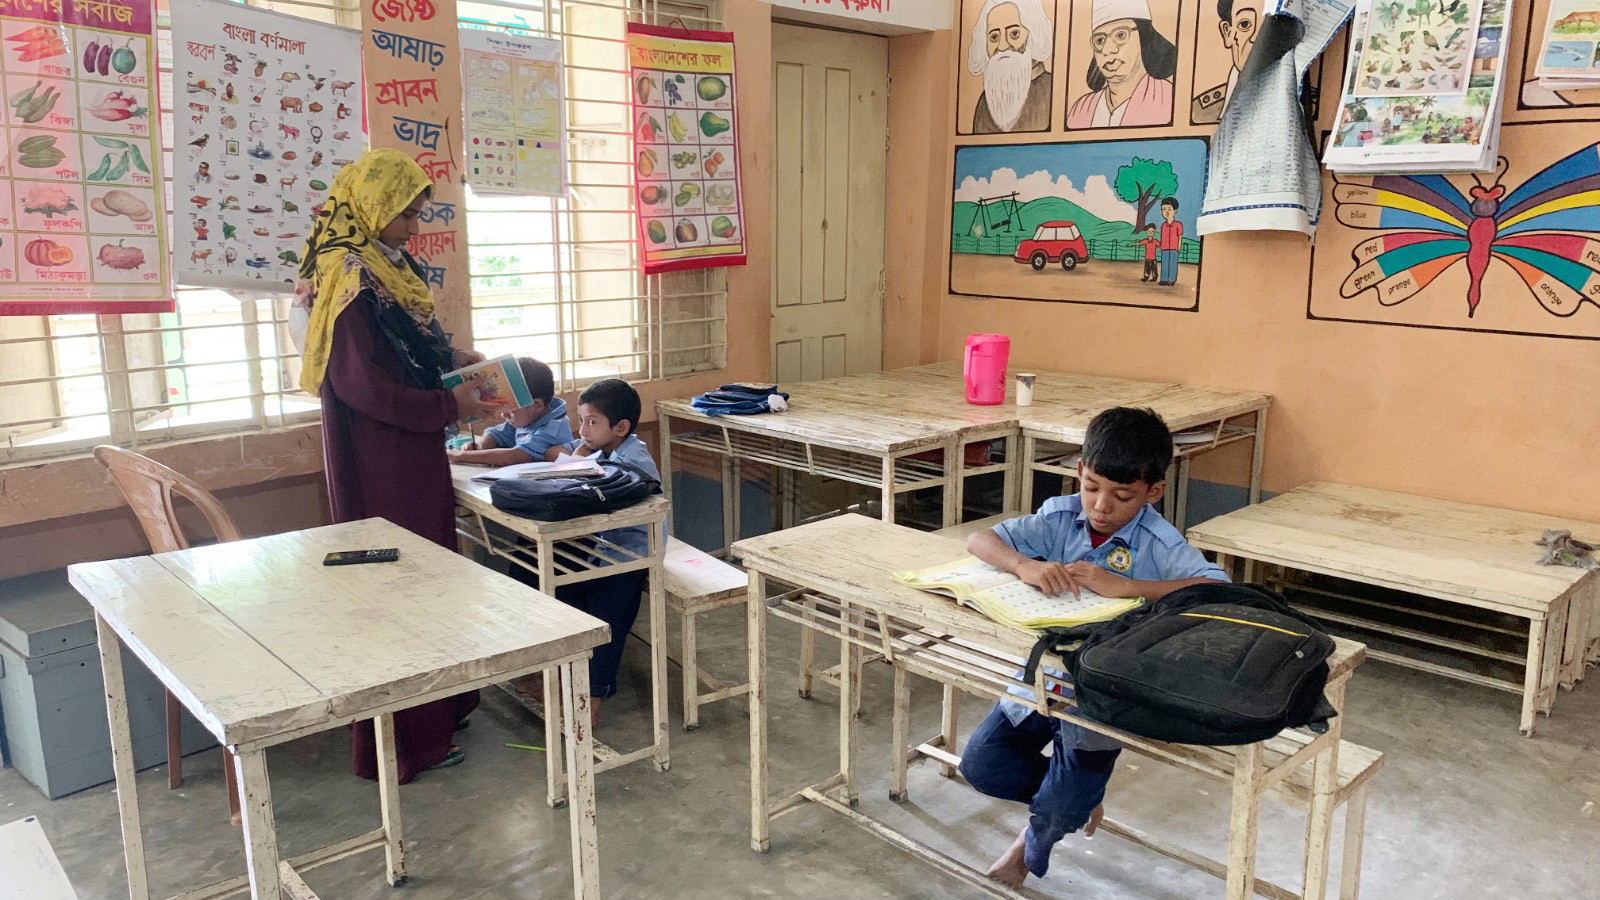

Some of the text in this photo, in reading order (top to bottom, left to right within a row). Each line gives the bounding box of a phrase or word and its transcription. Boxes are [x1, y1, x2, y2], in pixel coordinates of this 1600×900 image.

[223, 22, 307, 56] বাংলা বর্ণমালা
[371, 29, 446, 72] আষাঢ়
[636, 47, 723, 68] বাংলাদেশের ফল
[117, 74, 145, 84] বেগুন
[392, 116, 443, 151] ভাদ্র
[55, 169, 79, 180] পটল
[1346, 188, 1369, 199] yellow
[42, 217, 82, 230] ফুলকপি
[1350, 211, 1367, 219] blue
[408, 230, 458, 262] গ্রহায়ন
[1364, 242, 1378, 256] red
[35, 267, 87, 282] মিঠাকুমড়া
[1354, 270, 1376, 290] green
[1388, 278, 1411, 296] orange
[1540, 283, 1563, 306] orange
